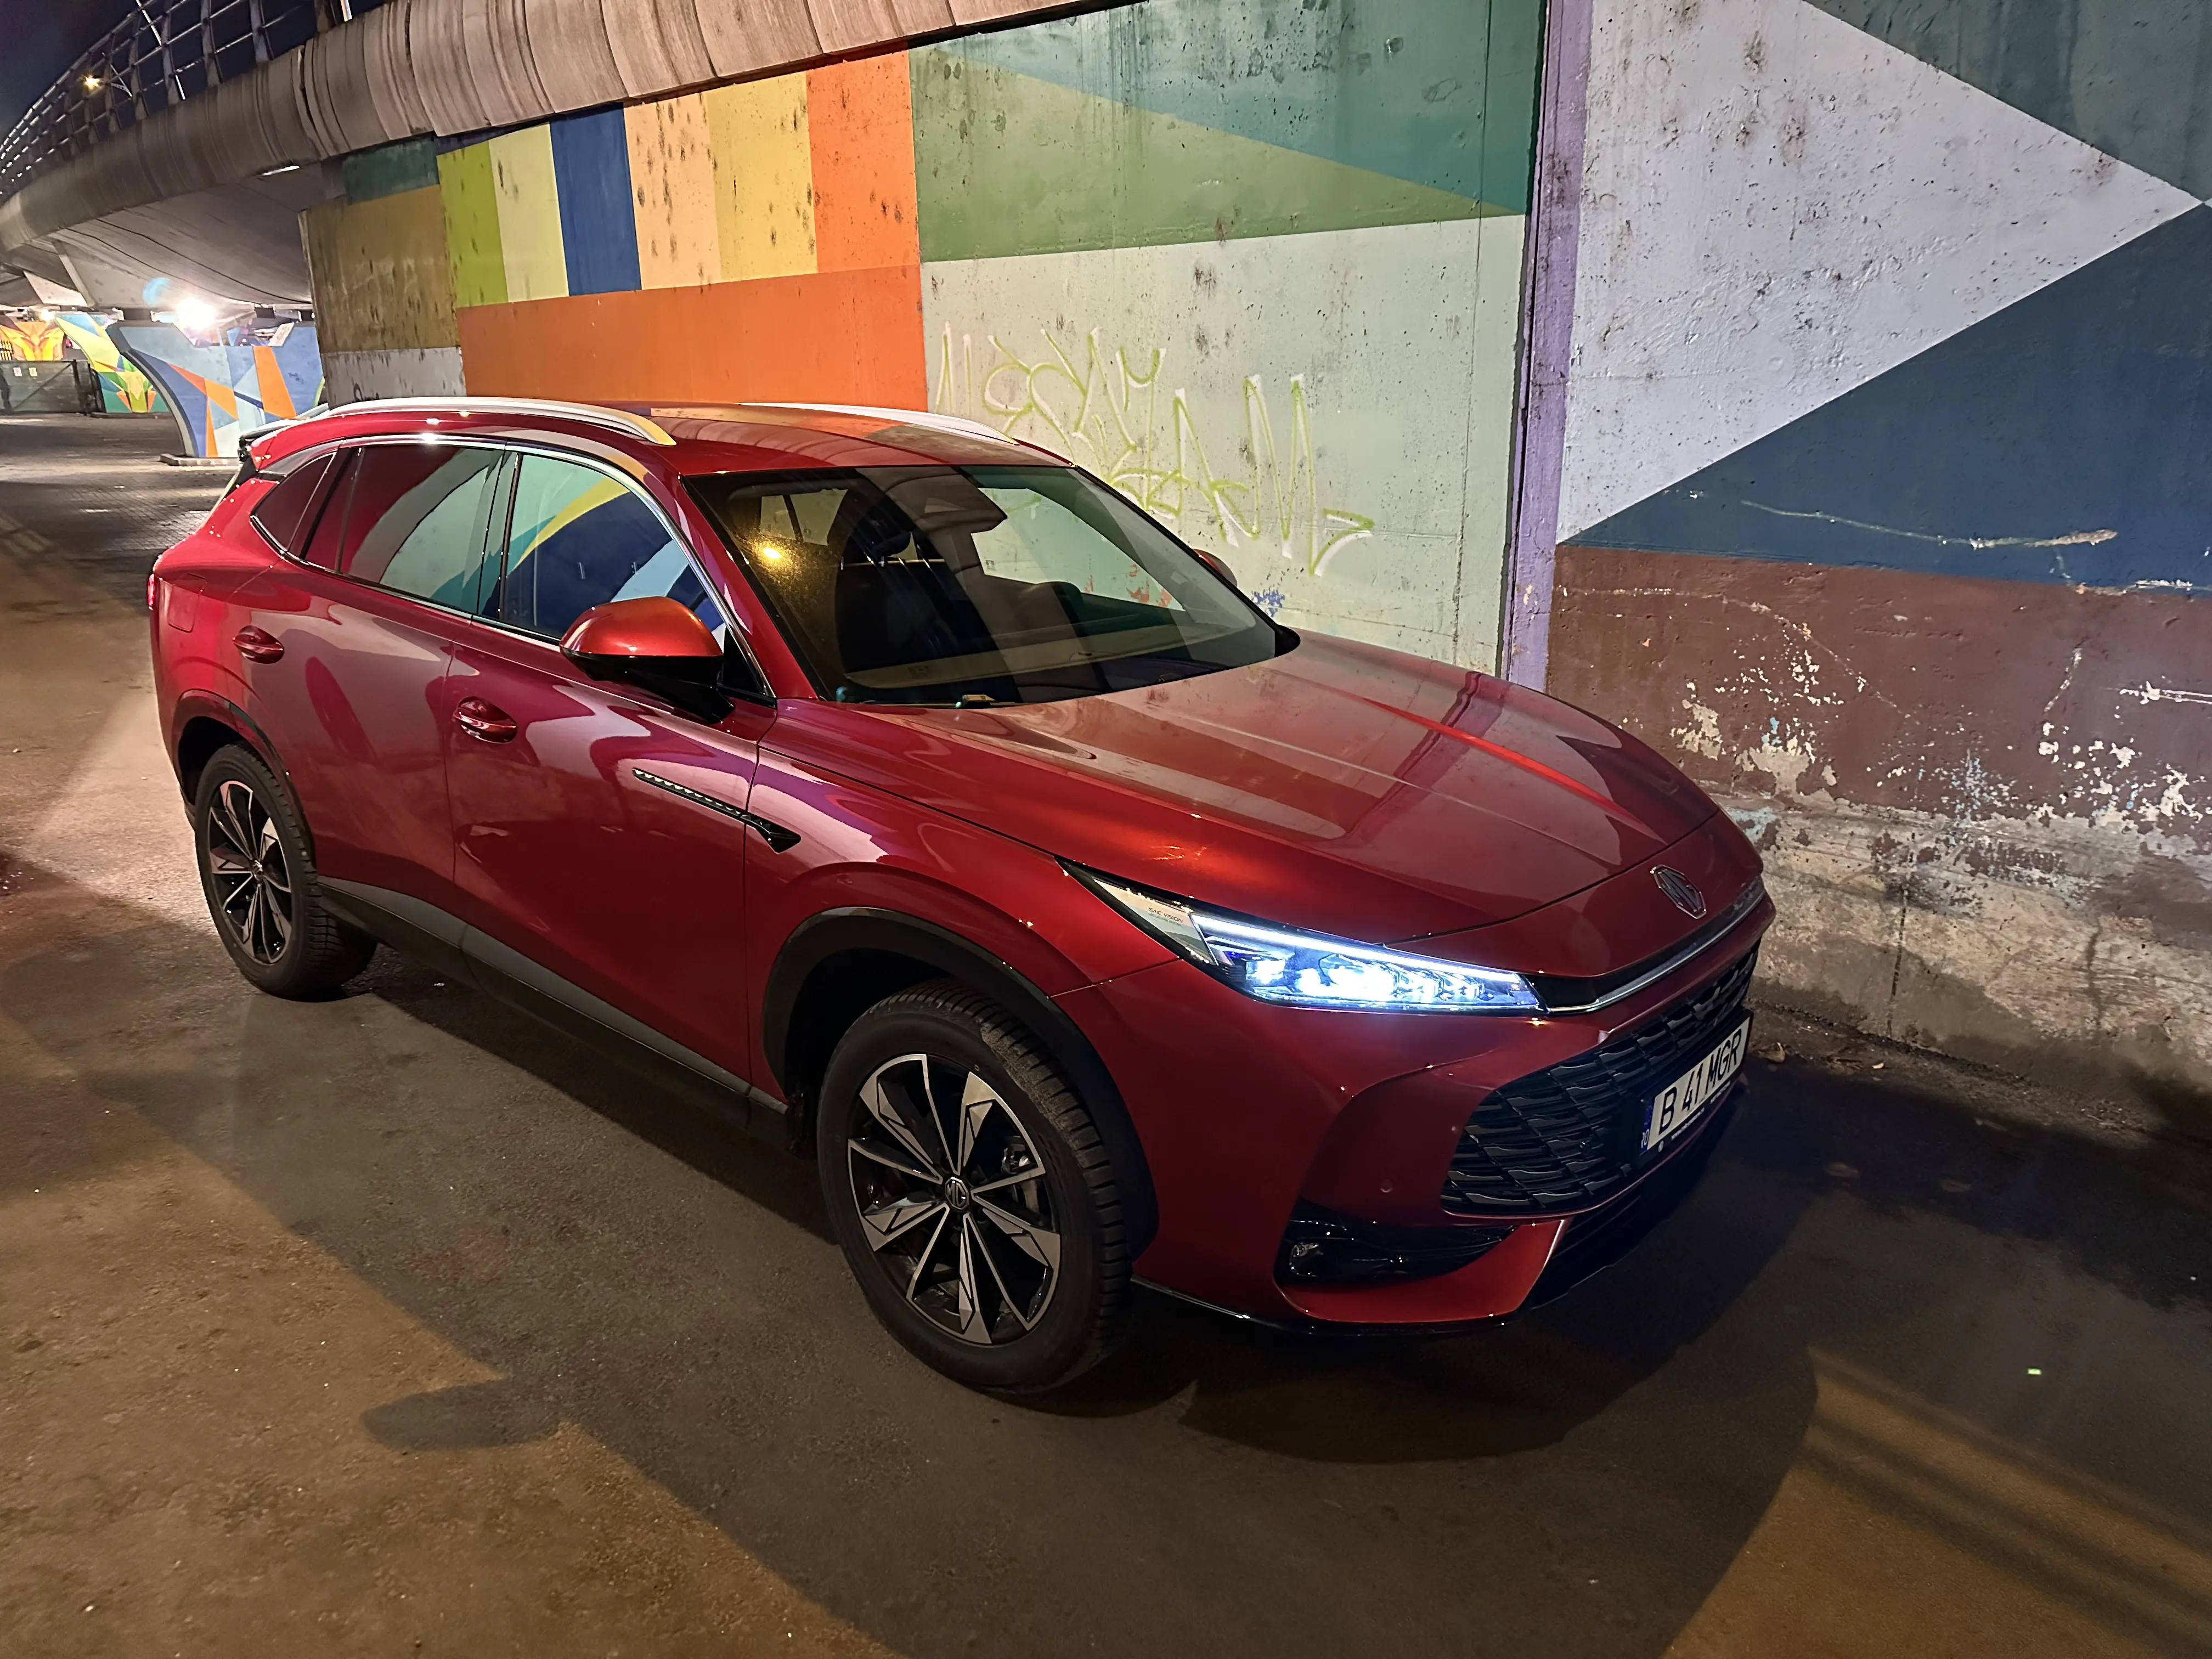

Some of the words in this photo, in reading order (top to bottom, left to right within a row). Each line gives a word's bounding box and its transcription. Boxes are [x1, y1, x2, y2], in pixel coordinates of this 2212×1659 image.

[1164, 913, 1183, 923] VISION
[1659, 1087, 1677, 1135] B
[1682, 1063, 1703, 1111] 41
[1706, 1029, 1742, 1094] MGR
[947, 1181, 966, 1207] MG
